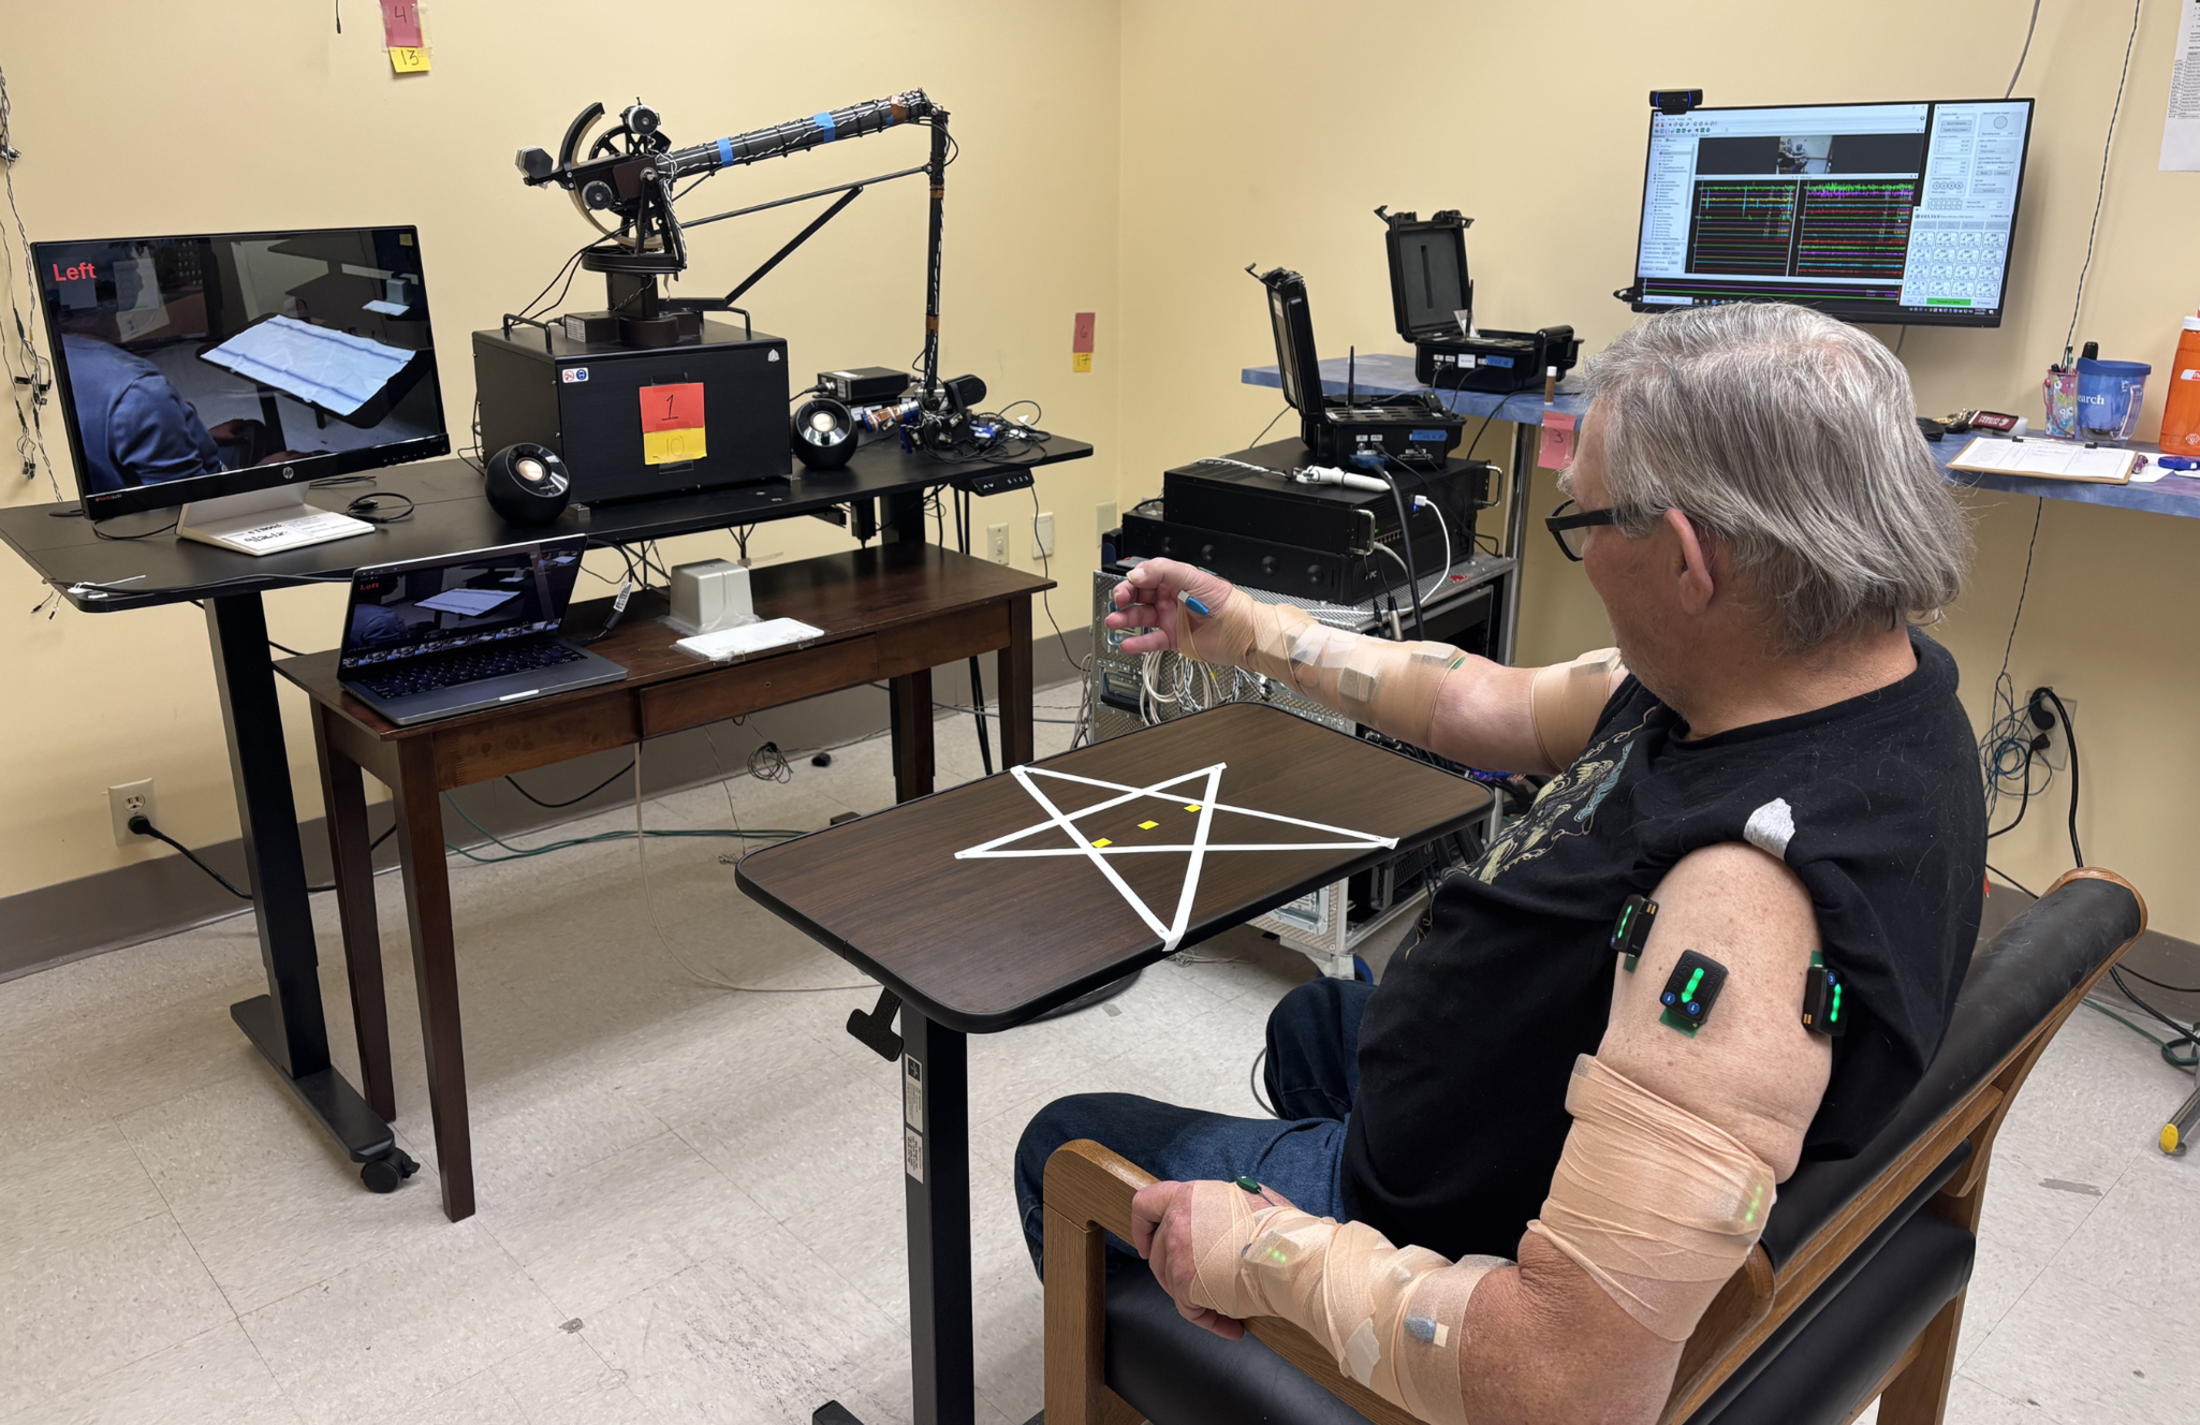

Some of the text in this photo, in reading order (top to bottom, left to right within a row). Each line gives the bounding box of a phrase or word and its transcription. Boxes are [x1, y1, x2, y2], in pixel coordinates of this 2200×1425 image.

[394, 5, 408, 24] 4
[400, 49, 420, 66] 13
[52, 261, 98, 282] Left
[1080, 324, 1089, 339] 6
[661, 393, 680, 421] 1
[1552, 427, 1564, 444] 3
[665, 435, 686, 457] 10
